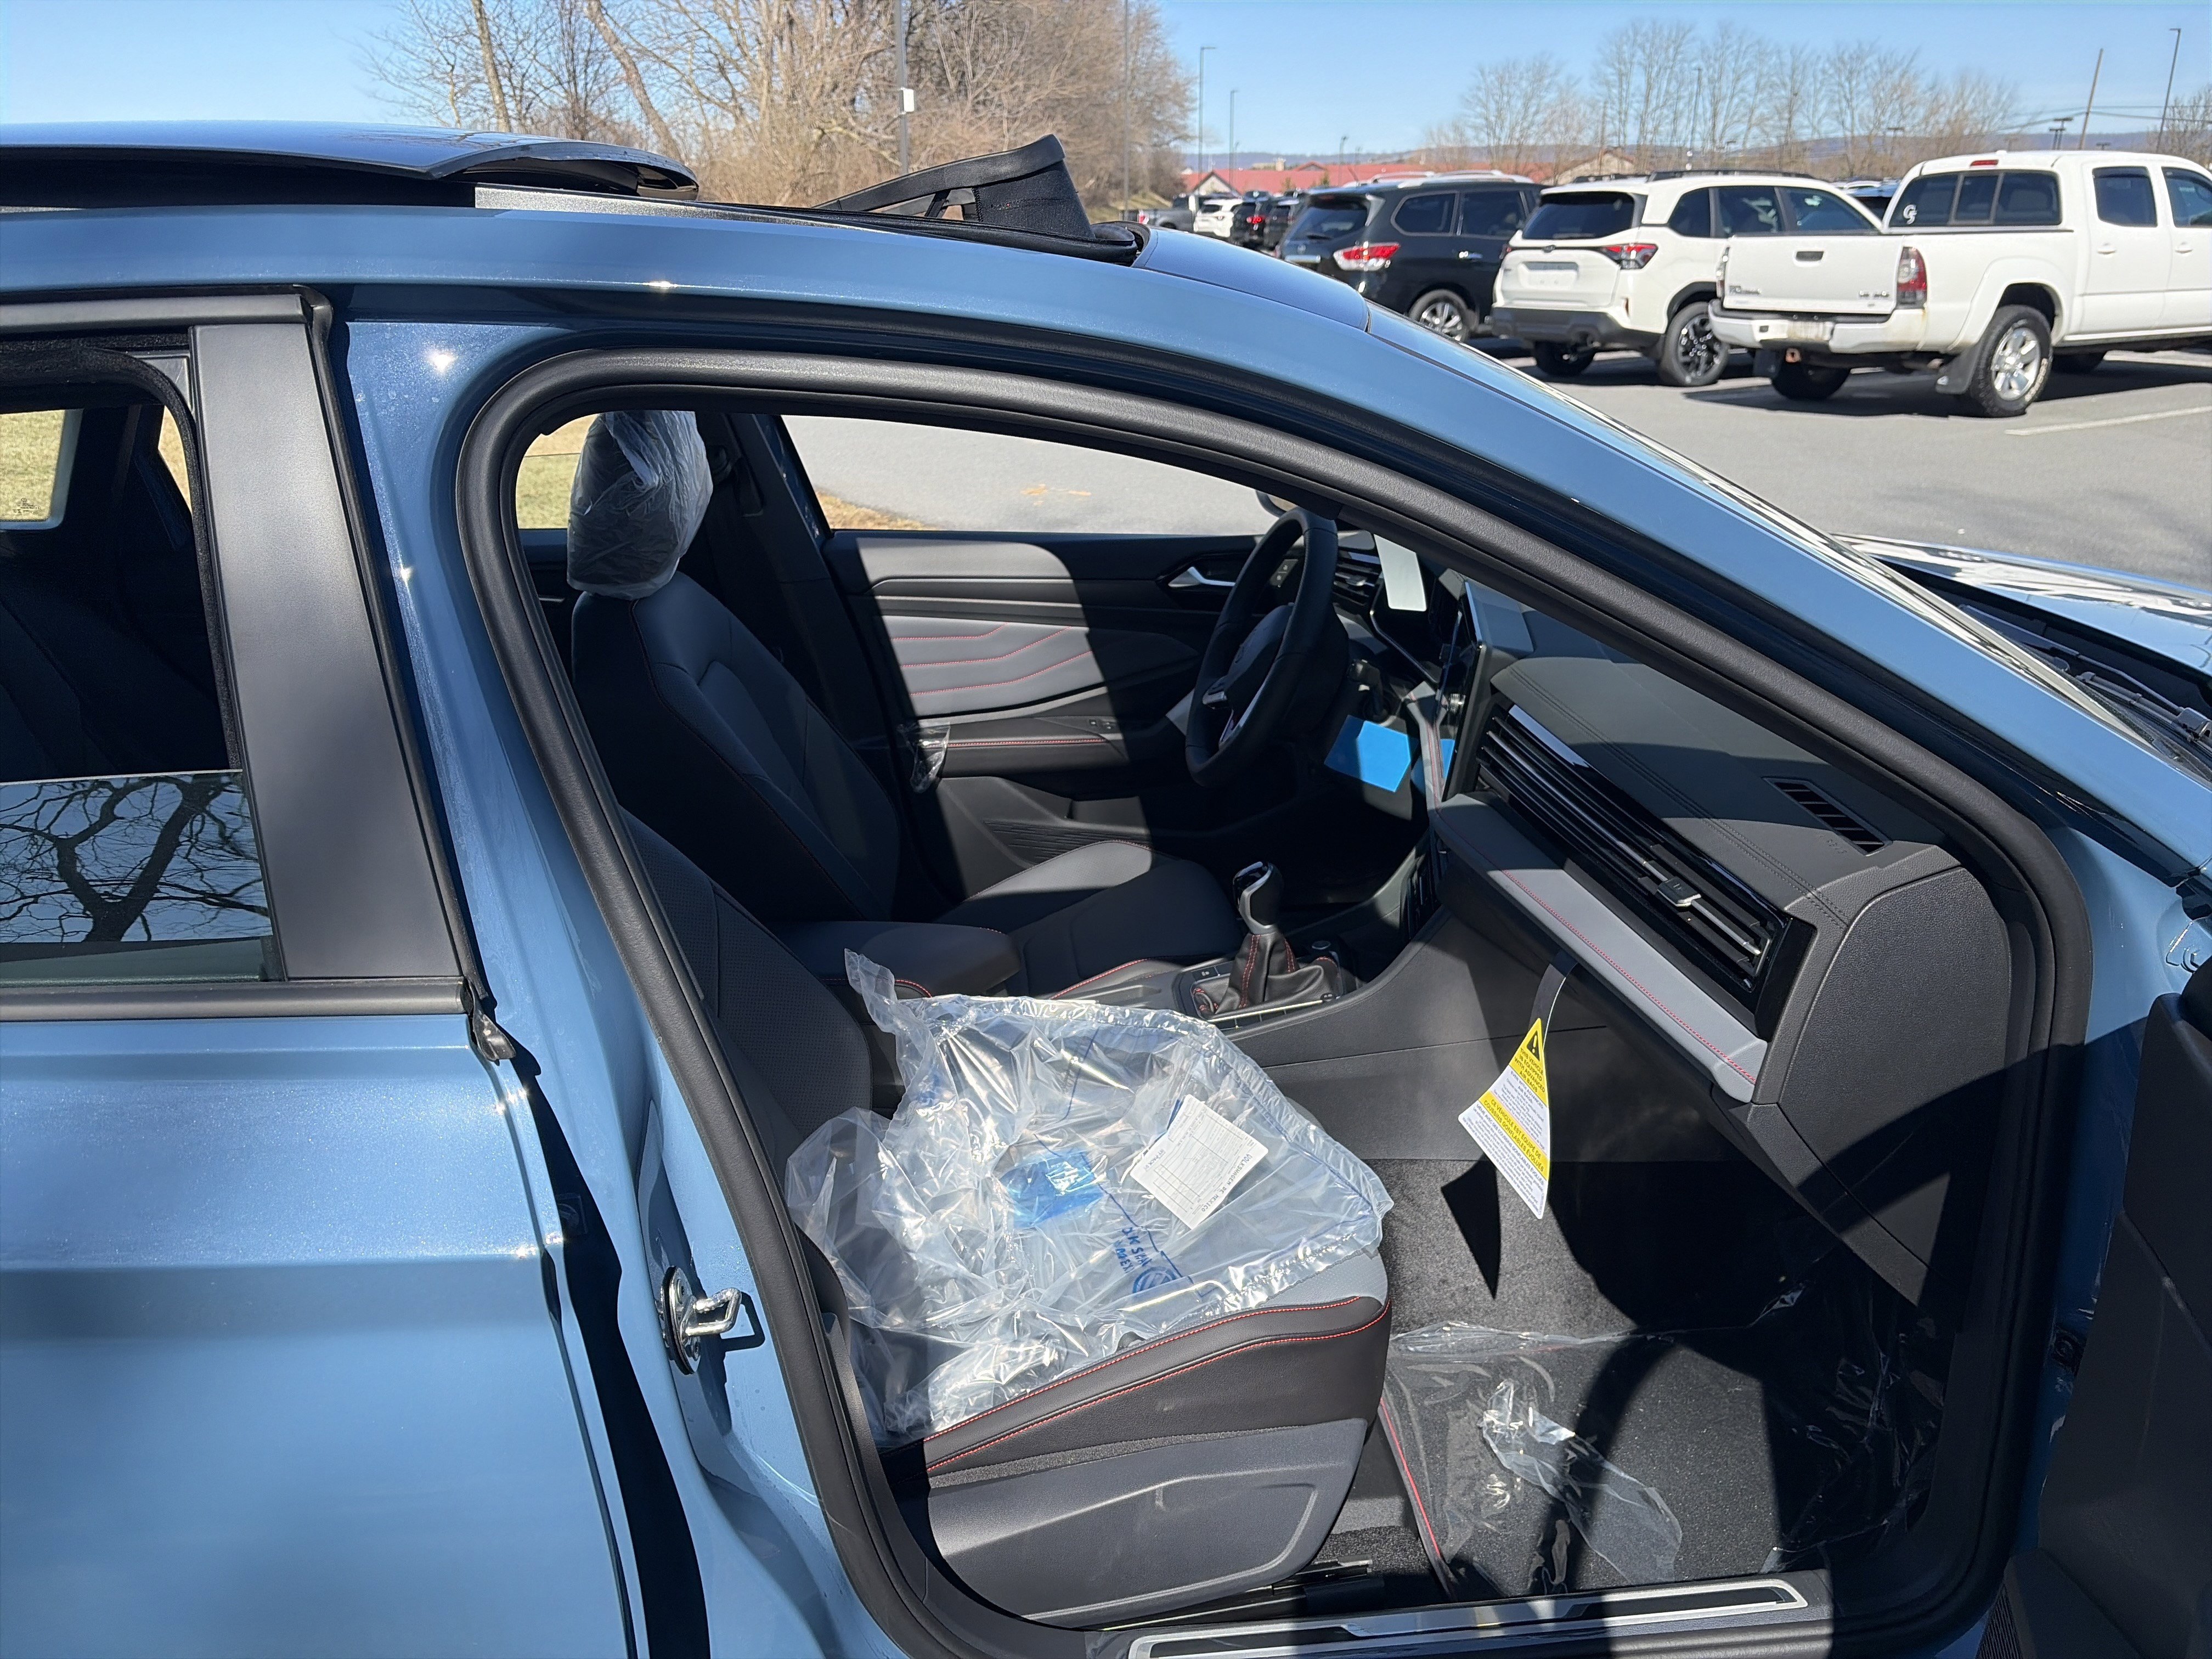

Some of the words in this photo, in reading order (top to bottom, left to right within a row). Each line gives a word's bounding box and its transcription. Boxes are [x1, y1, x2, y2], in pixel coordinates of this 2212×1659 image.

[1520, 1047, 1528, 1059] THIS
[1529, 1056, 1543, 1074] VEHICLE
[1524, 1059, 1542, 1081] EQUIPPED
[1515, 1057, 1525, 1070] WITH
[1525, 1068, 1545, 1093] ADVANCED
[1527, 1077, 1538, 1092] BAGS
[1483, 1099, 1503, 1123] COUSSINS
[1502, 1121, 1526, 1152] GONFLABLES
[1526, 1148, 1544, 1172] ÉVOLUÉS
[1491, 1099, 1497, 1108] CE
[1497, 1104, 1514, 1128] VÉHICULE
[1535, 1150, 1542, 1160] DE
[1227, 1153, 1253, 1186] VOLKSWAGEN
[1201, 1194, 1220, 1212] MEXICO
[1220, 1186, 1227, 1194] DE
